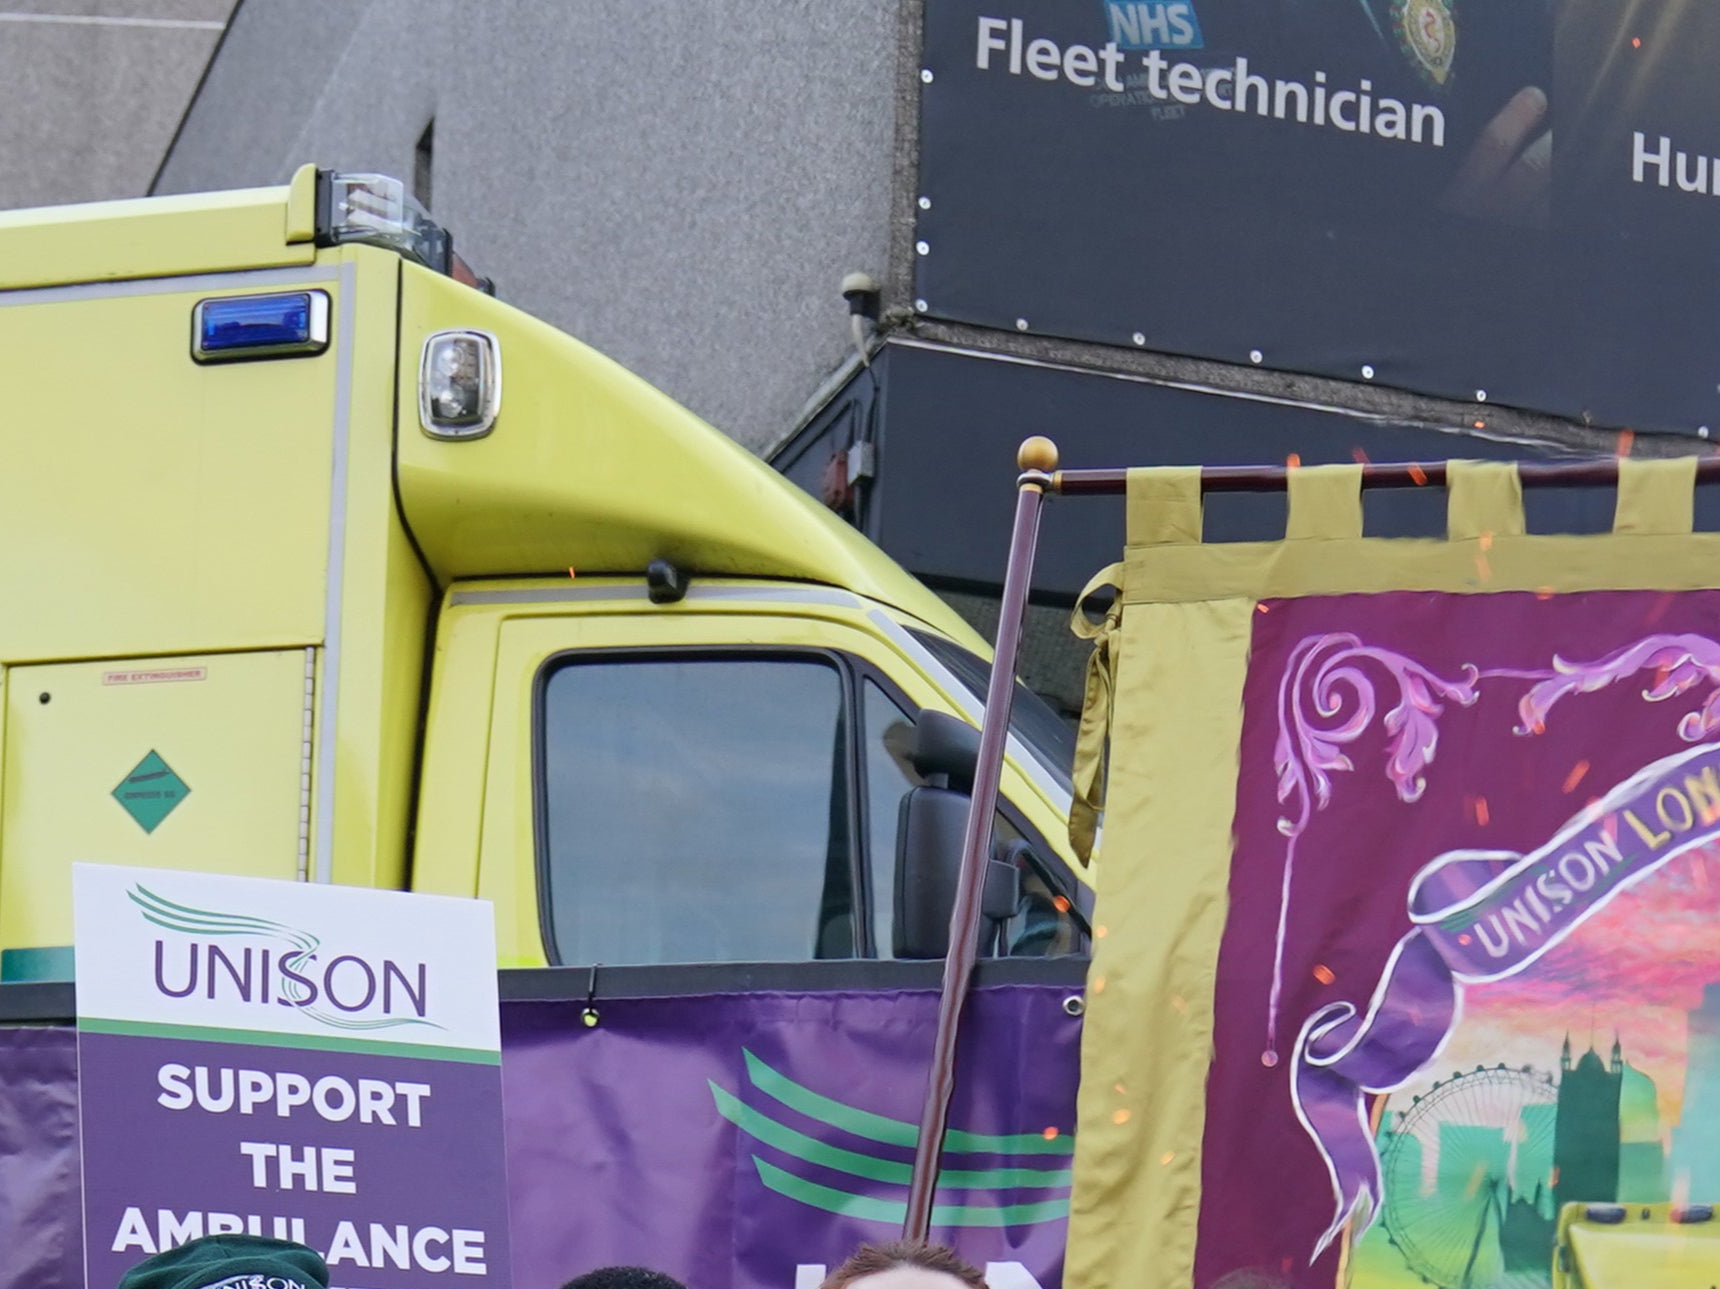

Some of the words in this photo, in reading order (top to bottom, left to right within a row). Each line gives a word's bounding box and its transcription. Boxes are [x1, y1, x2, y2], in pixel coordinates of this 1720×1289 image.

[1109, 2, 1194, 46] NHS
[977, 16, 1124, 92] Fleet
[1143, 49, 1445, 146] technician
[1474, 830, 1624, 958] UNISON
[154, 940, 427, 1018] UNISON
[157, 1063, 431, 1128] SUPPORT
[240, 1141, 358, 1195] THE
